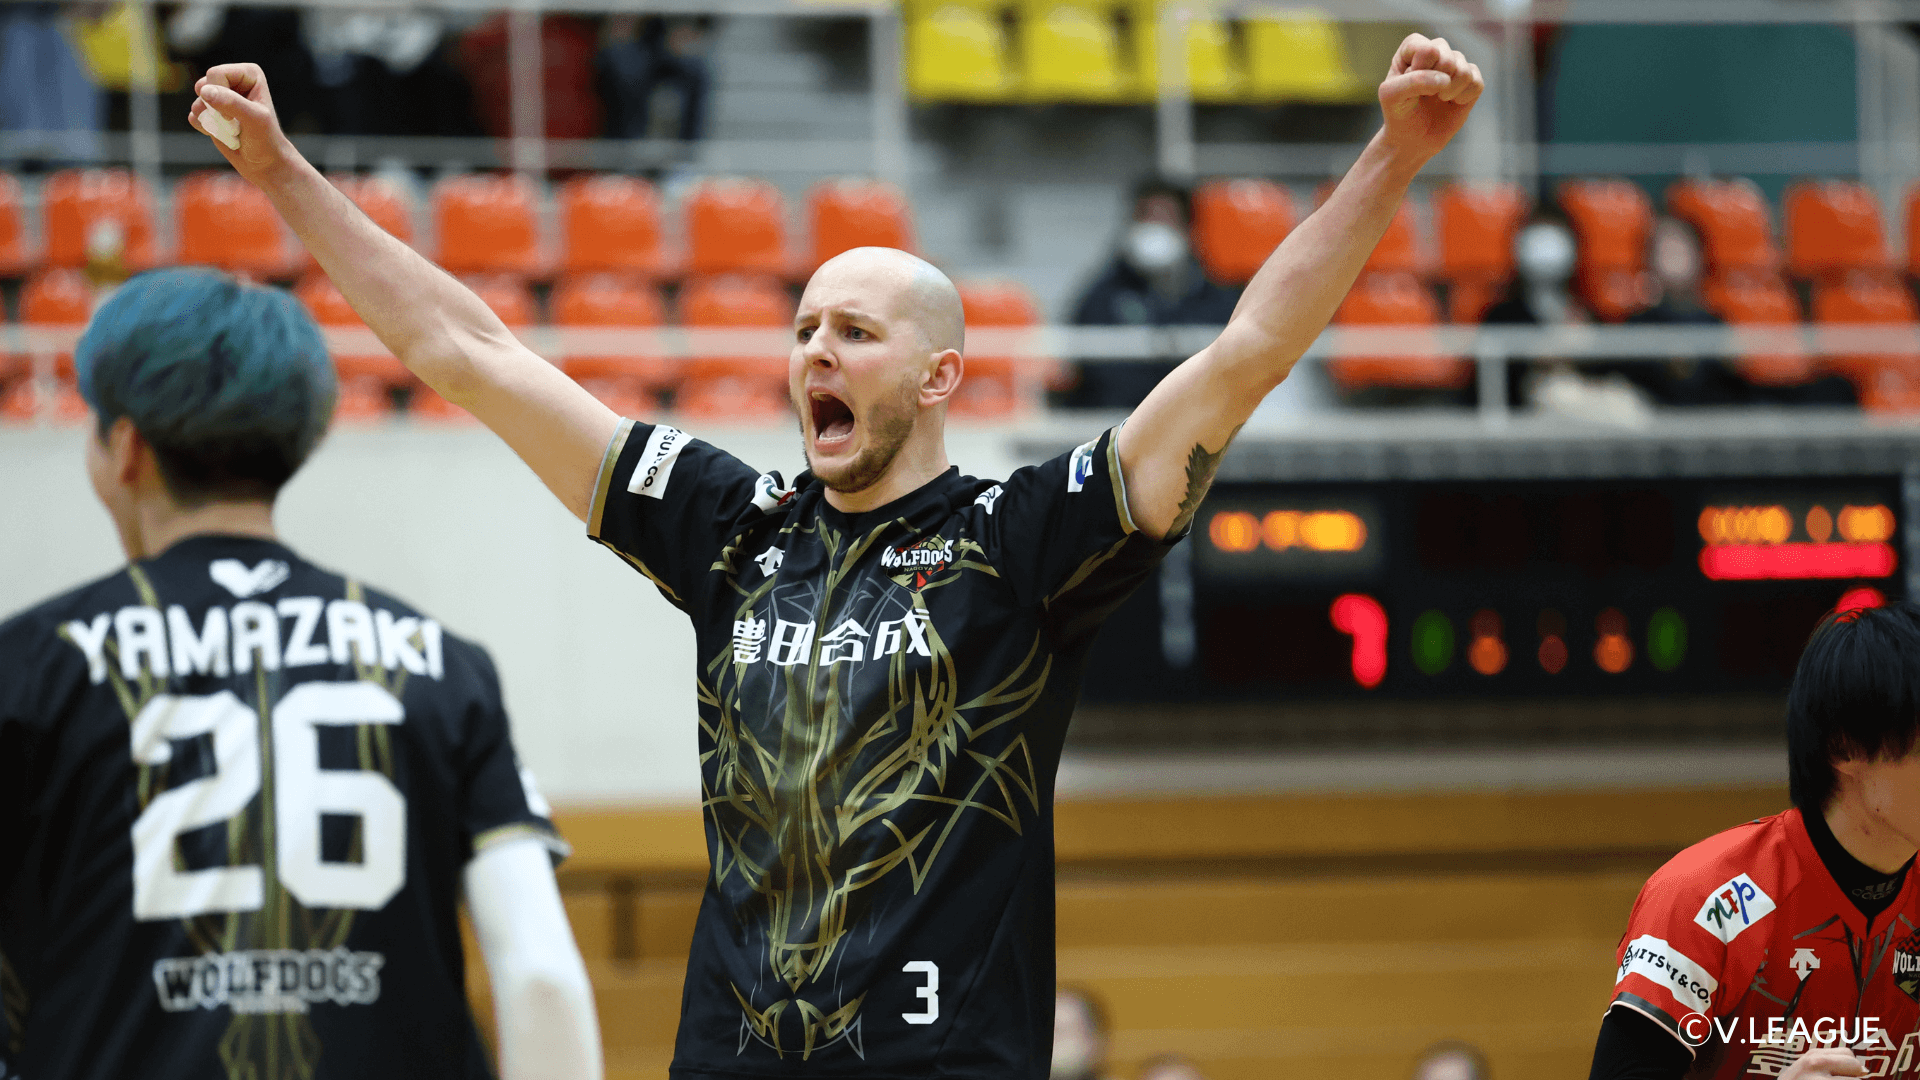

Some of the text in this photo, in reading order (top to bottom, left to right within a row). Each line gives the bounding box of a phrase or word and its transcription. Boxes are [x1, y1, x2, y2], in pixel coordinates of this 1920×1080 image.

[69, 597, 443, 684] YAMAZAKI
[733, 608, 932, 667] 豊田合成
[131, 681, 407, 922] 26
[155, 949, 383, 1007] WOLFDOGS
[902, 961, 939, 1024] 3
